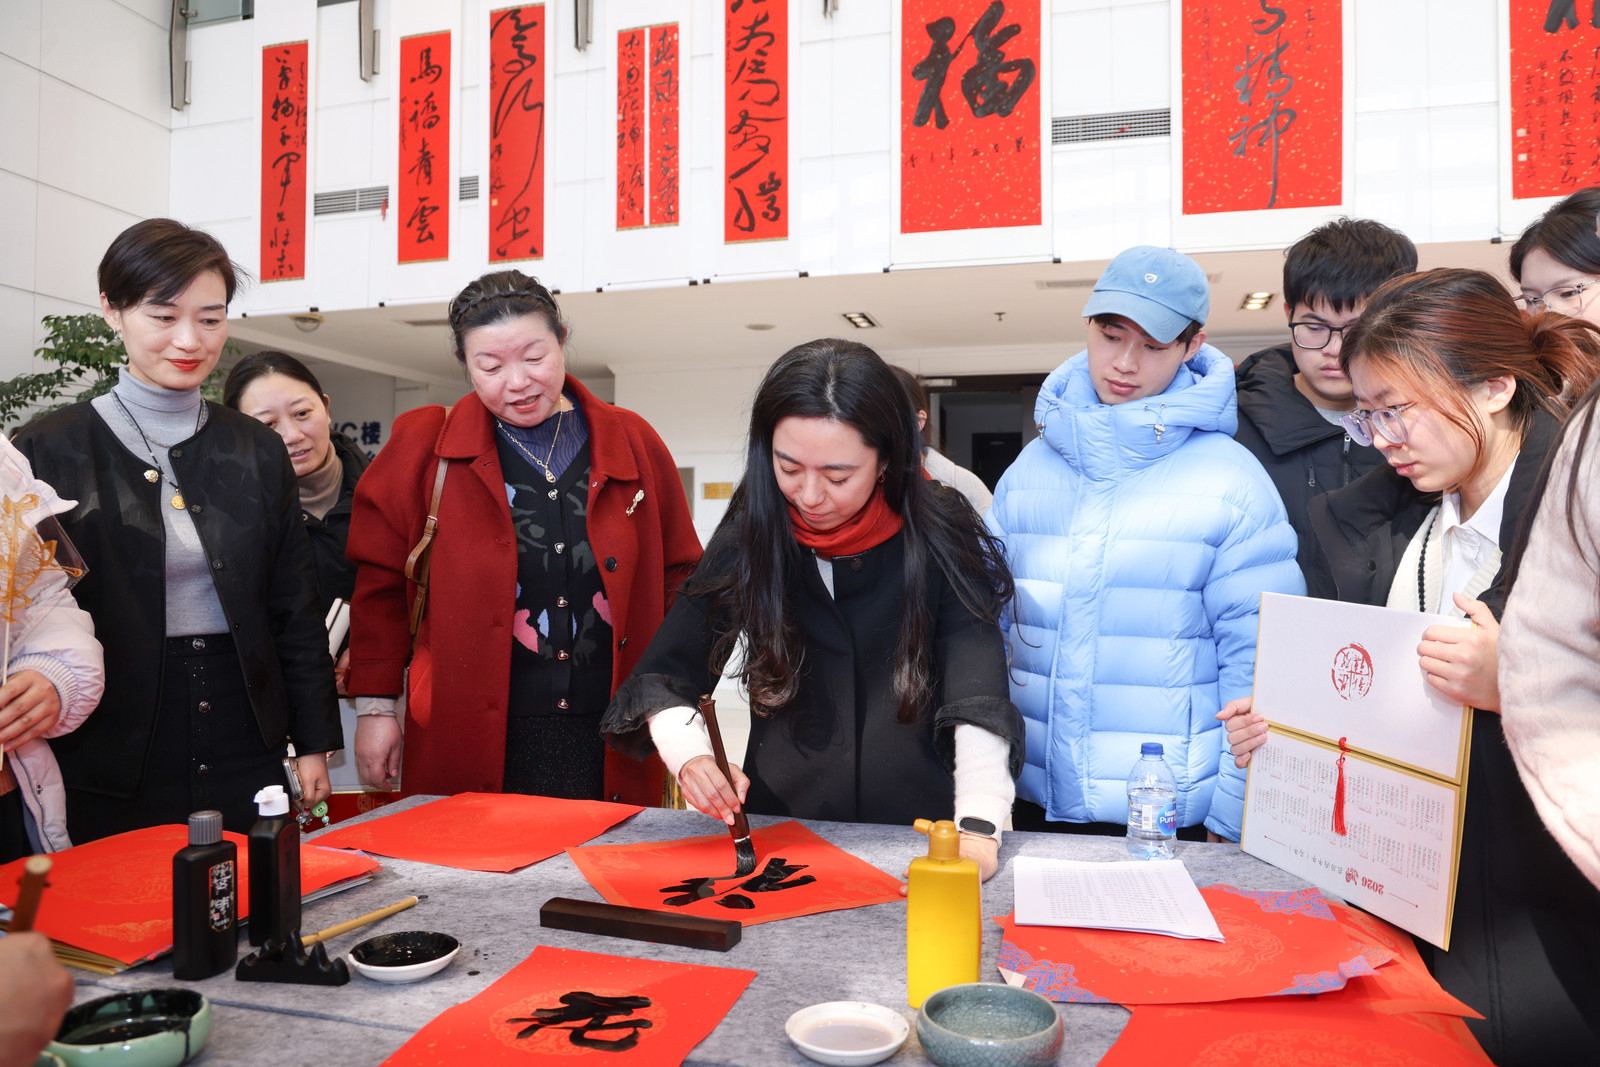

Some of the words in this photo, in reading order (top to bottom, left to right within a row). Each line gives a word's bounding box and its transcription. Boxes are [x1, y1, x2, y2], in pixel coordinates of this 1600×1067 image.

[912, 0, 1036, 130] 福
[334, 421, 381, 445] C楼
[1361, 876, 1385, 895] 2026
